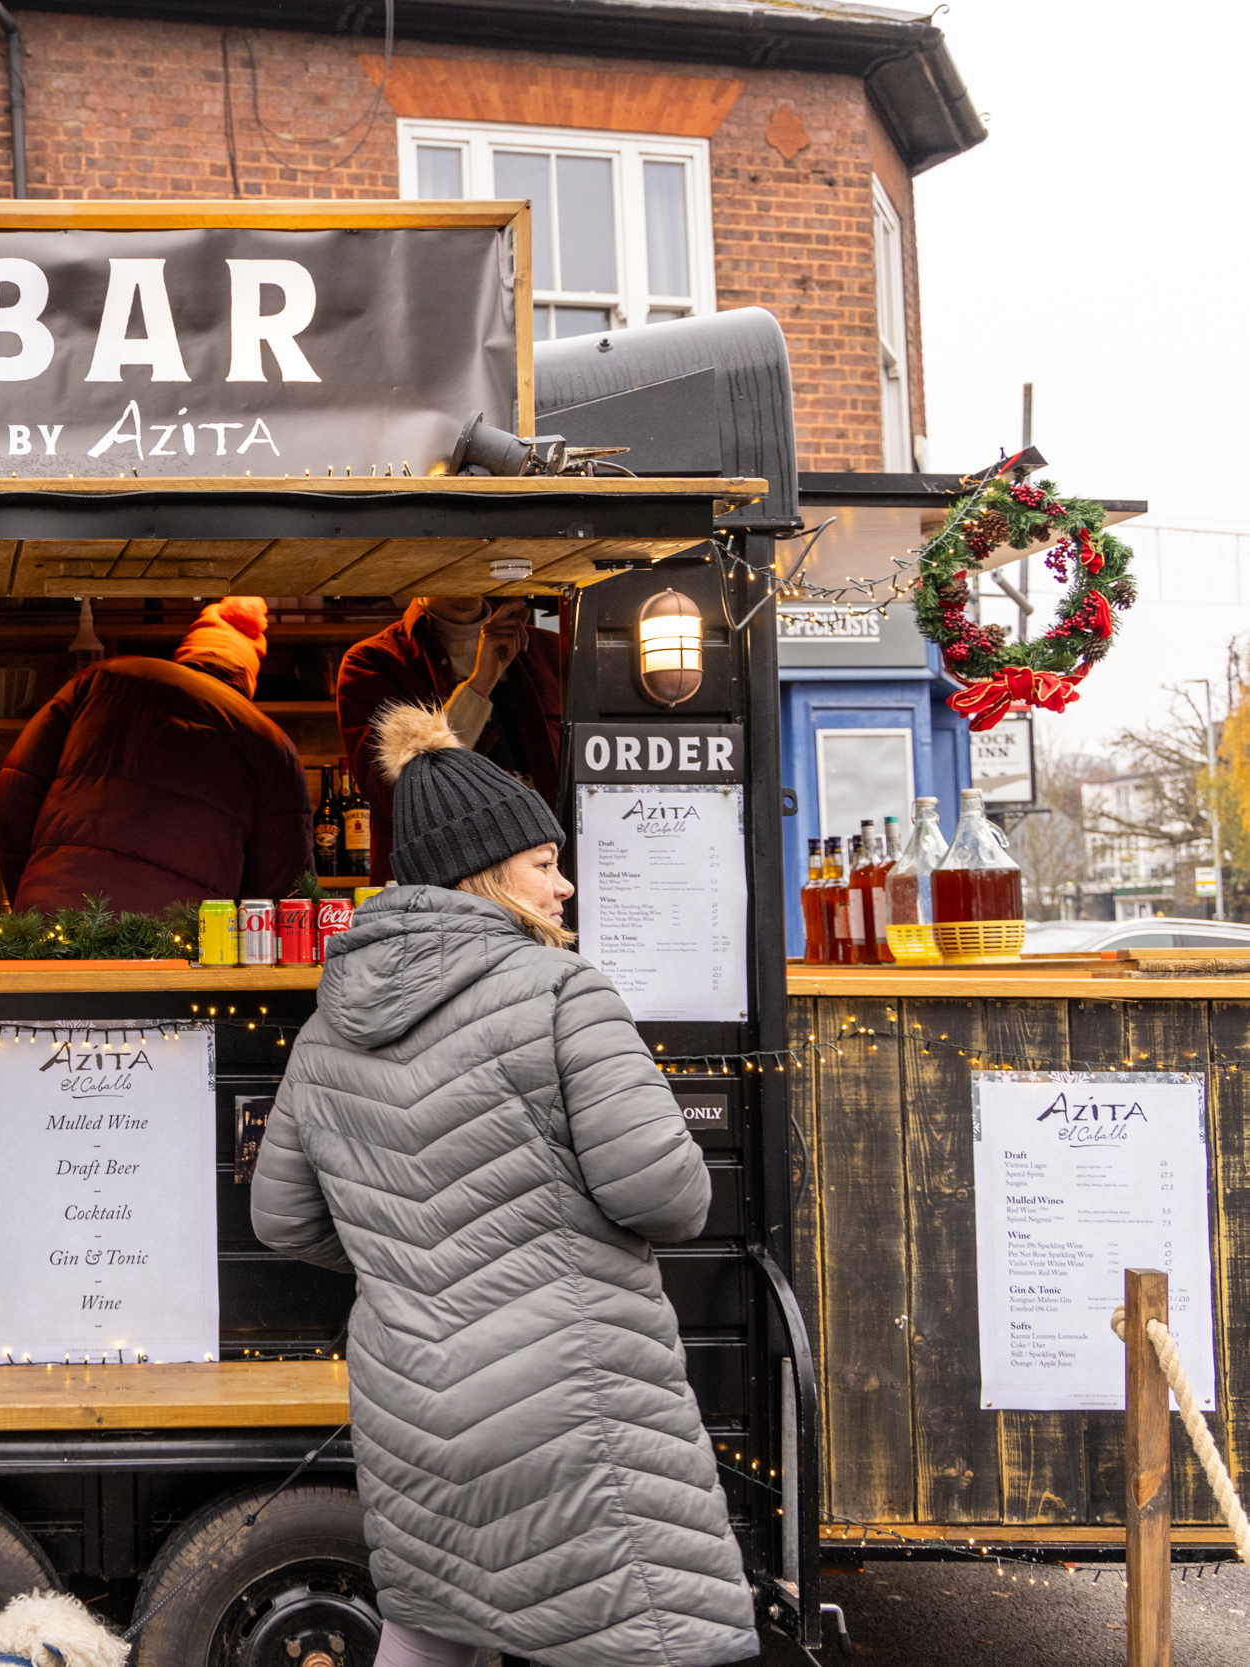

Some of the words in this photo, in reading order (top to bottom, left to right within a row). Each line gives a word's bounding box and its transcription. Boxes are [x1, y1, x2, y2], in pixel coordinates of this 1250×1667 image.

[8, 424, 64, 456] BY
[786, 614, 879, 635] SPECIALISTS
[970, 733, 1015, 744] COCK
[584, 736, 734, 771] ORDER
[978, 747, 1008, 758] INN
[238, 908, 276, 932] Cok
[79, 1074, 131, 1092] Caballo
[684, 1108, 722, 1119] ONLY
[46, 1115, 102, 1130] Mulled
[108, 1115, 148, 1130] Wine
[1005, 1151, 1027, 1159] Draft
[56, 1160, 100, 1180] Draft
[105, 1160, 140, 1176] Beer
[1005, 1162, 1029, 1170] Victoria
[1031, 1162, 1047, 1170] Lager
[1005, 1171, 1025, 1179] Aperol
[1027, 1171, 1045, 1179] Spritz
[1006, 1180, 1028, 1188] Sangria
[1006, 1196, 1036, 1205] Mulled
[1038, 1196, 1064, 1205] Wines
[64, 1205, 132, 1221] Cocktails
[1007, 1216, 1027, 1224] Spiced
[1028, 1216, 1052, 1224] Negroni
[1008, 1231, 1031, 1240] Wine
[1038, 1242, 1065, 1250] Sparkling
[1067, 1242, 1083, 1250] Wine
[49, 1250, 80, 1266] Gin
[84, 1250, 103, 1266] &
[106, 1250, 148, 1266] Tonic
[1009, 1286, 1026, 1294] Gin
[1027, 1286, 1036, 1294] &
[1038, 1286, 1061, 1294] Tonic
[81, 1294, 122, 1311] Wine
[1037, 1296, 1058, 1304] Mahon
[1060, 1296, 1072, 1304] Gin
[1010, 1322, 1032, 1330] Softs
[1011, 1333, 1030, 1341] Karma
[1032, 1333, 1056, 1341] Lemony
[1058, 1333, 1088, 1341] Lemonade
[1011, 1351, 1023, 1359] Still
[1029, 1351, 1057, 1359] Sparkling
[1059, 1351, 1076, 1359] Water
[1011, 1360, 1033, 1368] Orange
[1039, 1360, 1055, 1368] Apple
[1057, 1360, 1072, 1368] Juice
